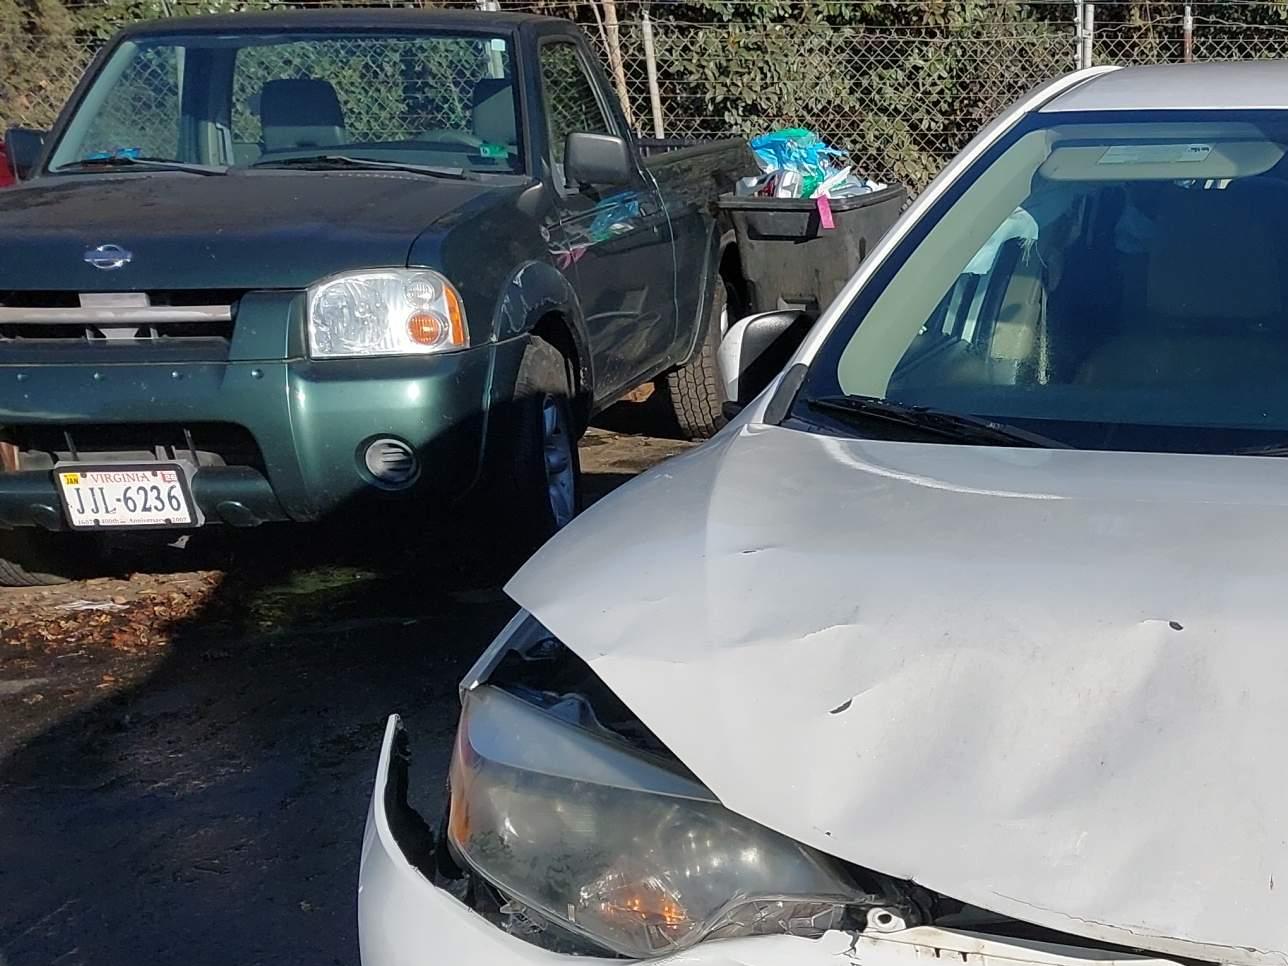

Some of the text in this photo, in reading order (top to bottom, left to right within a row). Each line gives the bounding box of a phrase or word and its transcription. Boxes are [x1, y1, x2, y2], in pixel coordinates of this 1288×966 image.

[66, 477, 79, 485] JAN
[91, 472, 151, 484] VIRGINIA
[74, 485, 181, 514] JJL-6236
